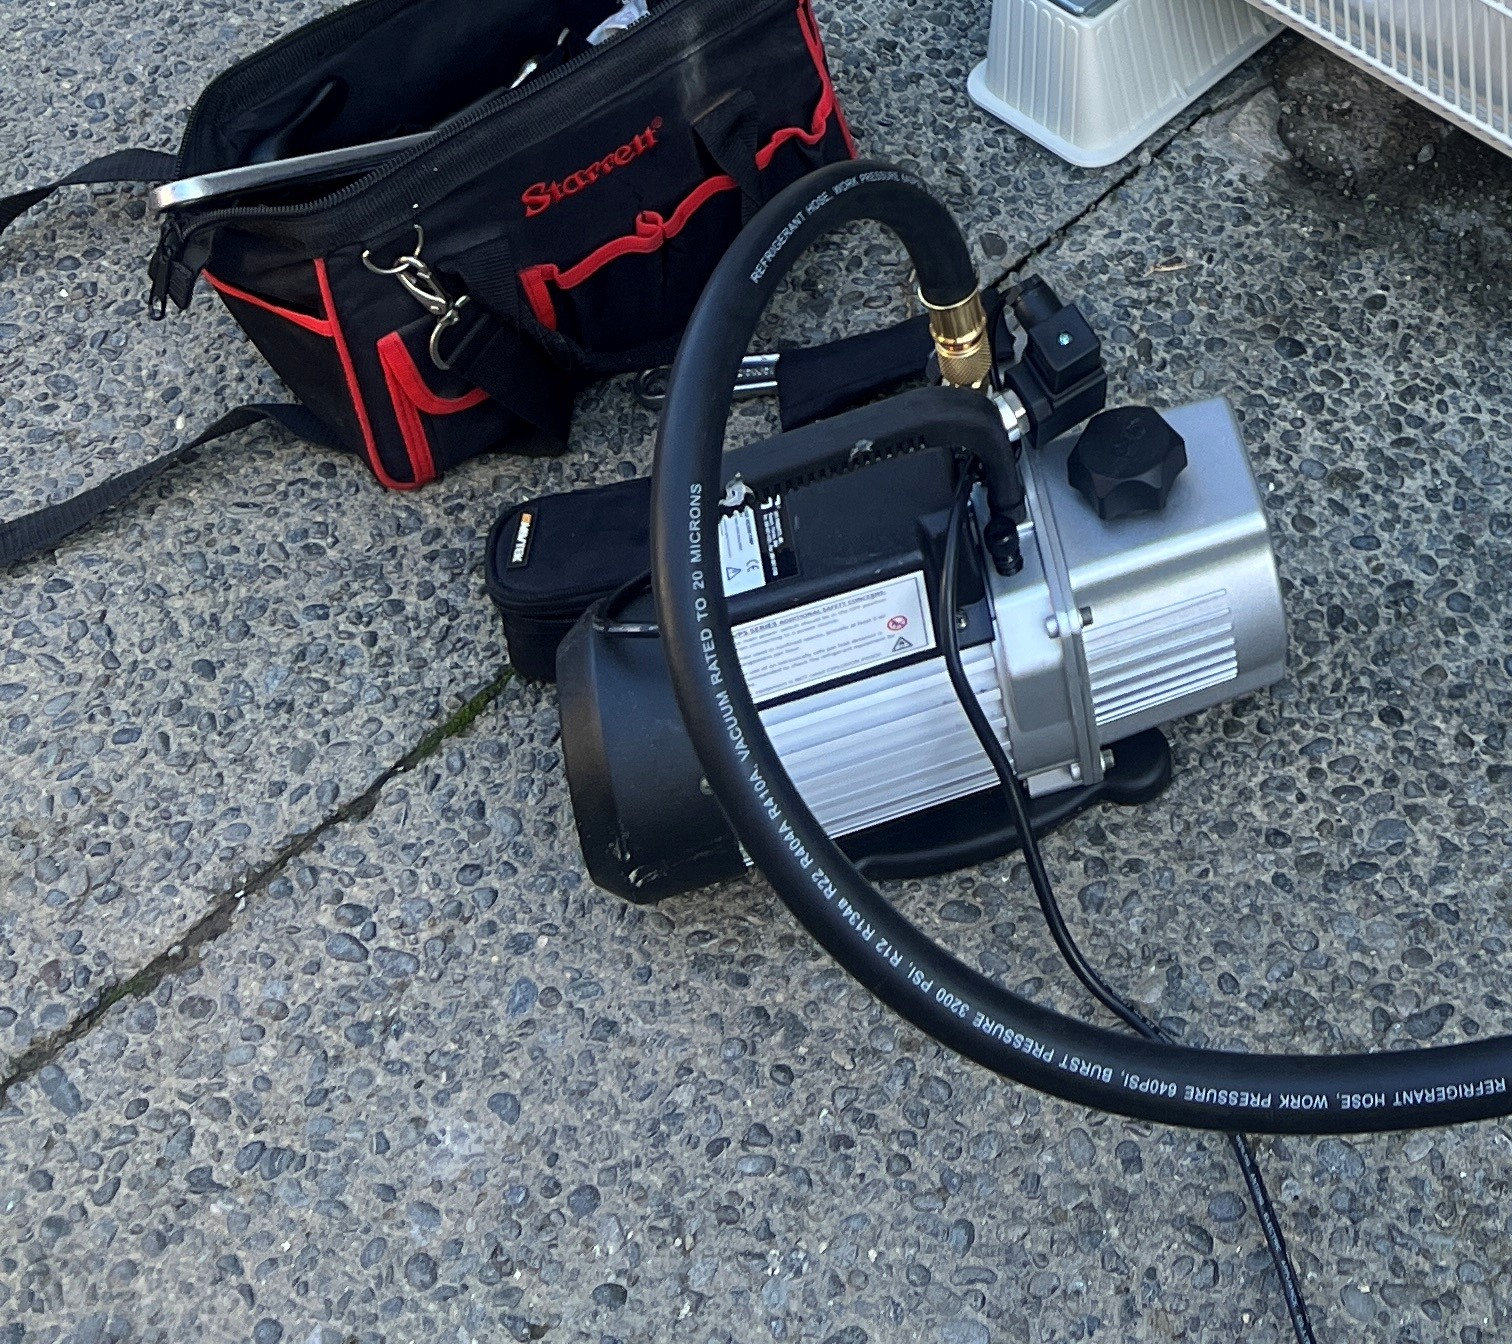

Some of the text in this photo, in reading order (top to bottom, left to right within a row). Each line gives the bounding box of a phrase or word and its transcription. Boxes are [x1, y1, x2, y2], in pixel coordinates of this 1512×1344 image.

[521, 126, 658, 217] Starrett
[750, 211, 805, 284] REFRIGERANT
[689, 483, 702, 563] MICRONS
[692, 570, 704, 590] 20
[694, 597, 708, 622] TO
[700, 627, 723, 685] RATED
[717, 693, 751, 762] VACUUM
[749, 763, 782, 820] R410A,
[778, 819, 813, 869] R404A
[811, 867, 837, 900] R22
[838, 897, 876, 942] R134a
[875, 937, 904, 968] R12
[907, 961, 934, 993] PSI,
[936, 987, 970, 1018] 3200
[973, 1011, 1055, 1063] PRESSURE
[1058, 1053, 1113, 1083] BURST
[1121, 1070, 1177, 1098] 640PSI,
[1183, 1085, 1272, 1108] PRESSURE
[1278, 1094, 1328, 1110] WORK
[1336, 1092, 1386, 1109] HOSE,
[1392, 1077, 1507, 1107] REFRIGERANT
